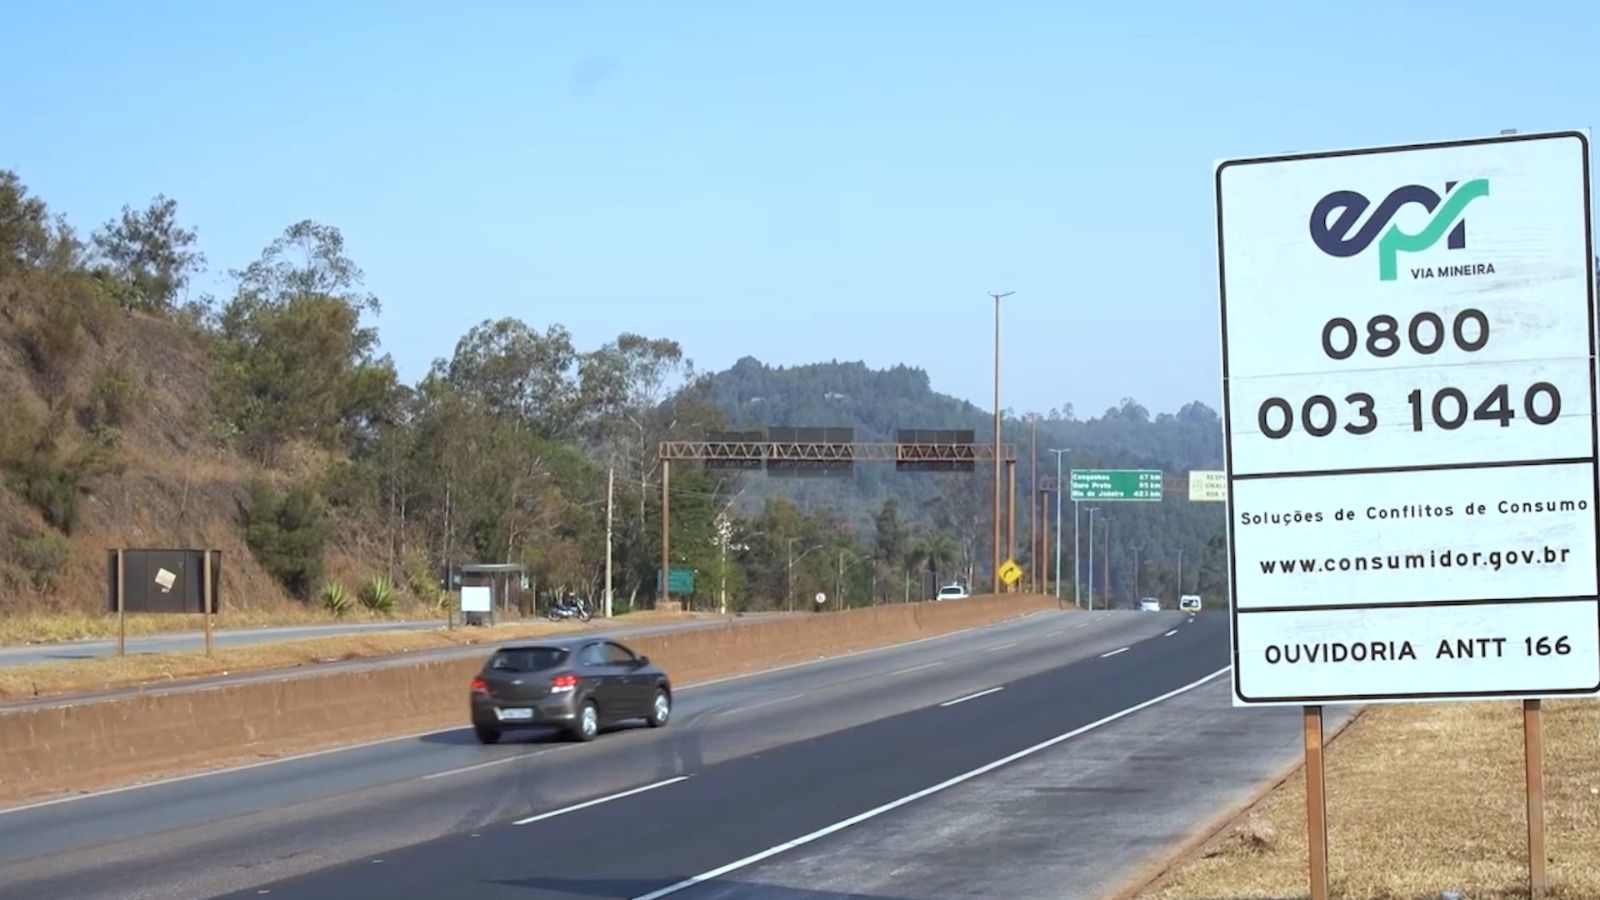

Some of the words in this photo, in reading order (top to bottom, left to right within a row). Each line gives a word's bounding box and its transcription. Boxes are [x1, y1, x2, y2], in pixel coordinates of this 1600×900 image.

[1309, 178, 1490, 281] epr
[1410, 268, 1434, 279] VIA
[1437, 263, 1495, 278] MINEIRA
[1321, 308, 1490, 361] 0800
[1257, 392, 1378, 440] 003
[1407, 381, 1562, 432] 1040
[1241, 510, 1324, 526] Soluções
[1334, 508, 1355, 521] de
[1366, 504, 1454, 520] Conflitos
[1465, 502, 1486, 516] de
[1497, 499, 1588, 514] Consumo
[1259, 545, 1571, 574] www.consumidor.gov.br
[1264, 640, 1417, 665] OUVIDORIA
[1435, 637, 1507, 660] ANTT
[1524, 635, 1572, 657] 166
